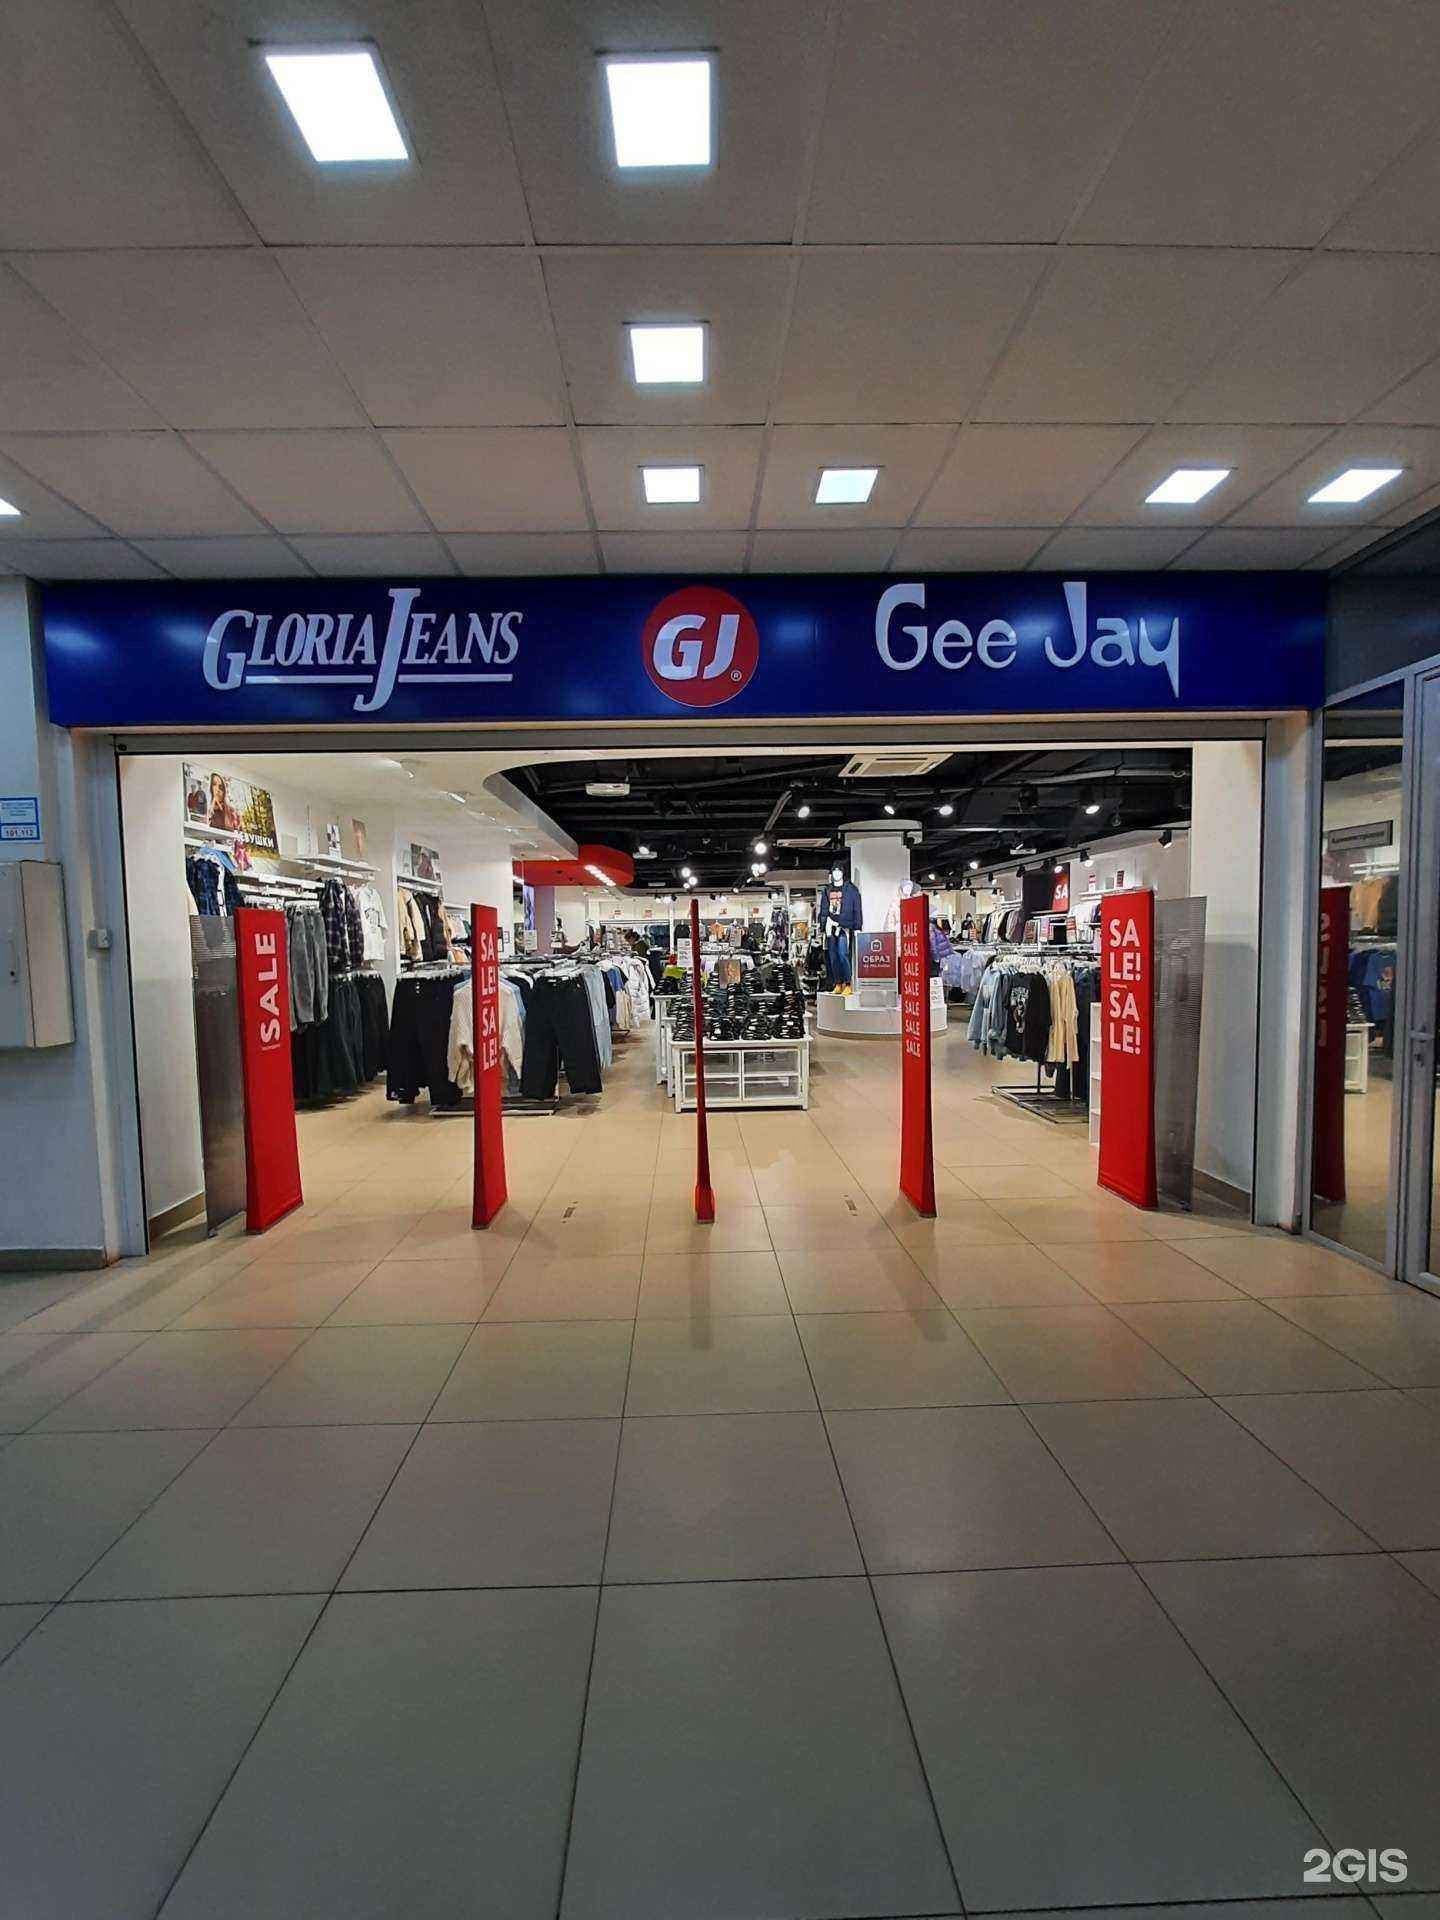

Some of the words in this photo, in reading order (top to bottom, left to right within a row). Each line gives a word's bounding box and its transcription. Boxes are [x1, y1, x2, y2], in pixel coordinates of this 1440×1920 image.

[203, 610, 377, 690] GLORIA
[353, 588, 523, 712] JEANS
[875, 582, 1017, 671] Gee
[1045, 581, 1179, 699] Jay
[903, 922, 918, 937] SALE
[1109, 918, 1141, 948] SA
[480, 932, 495, 962] SA
[903, 942, 918, 957] SALE
[481, 966, 496, 996] LE!
[904, 962, 919, 977] SALE
[1109, 951, 1141, 982] LE!
[254, 932, 281, 1044] SALE
[904, 981, 919, 997] SALE
[905, 1000, 920, 1016] SALE
[1109, 990, 1140, 1022] SA
[482, 1006, 496, 1037] SA
[905, 1019, 920, 1036] SALE
[906, 1039, 920, 1058] SALE
[1109, 1022, 1141, 1055] LE!
[483, 1037, 497, 1071] LE!
